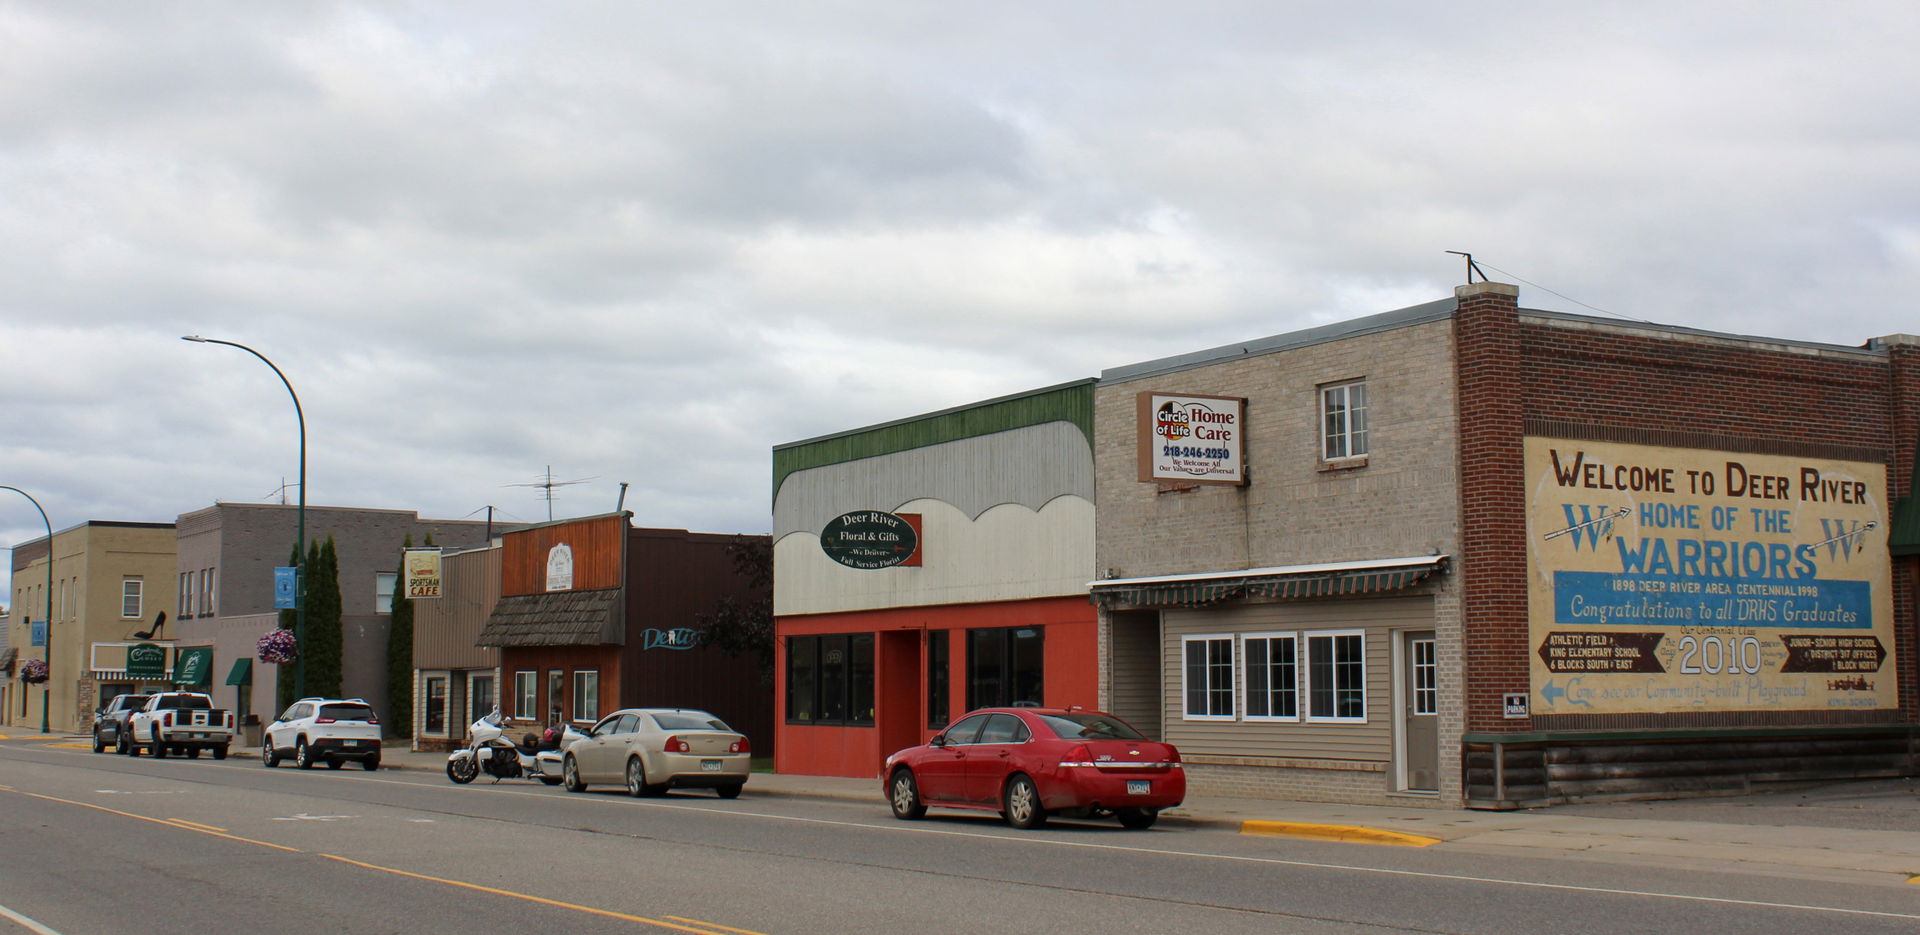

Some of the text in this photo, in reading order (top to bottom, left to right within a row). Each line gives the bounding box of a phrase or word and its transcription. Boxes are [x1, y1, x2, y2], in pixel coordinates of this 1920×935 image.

[1157, 409, 1189, 424] Circle
[1191, 408, 1235, 425] Home
[1156, 424, 1190, 437] of Life
[1195, 426, 1232, 441] Care
[1163, 445, 1230, 460] 218-246-2250
[1174, 465, 1193, 473] Values
[1206, 467, 1235, 475] Universal
[1183, 459, 1210, 467] Welcome
[1212, 460, 1221, 468] All
[1550, 448, 1866, 505] WELCOME TO DEER RIVER
[842, 512, 899, 528] Deer River
[1639, 502, 1791, 534] HOME OF THE
[840, 531, 899, 541] Floral & Gifts
[840, 556, 854, 566] Full
[880, 556, 901, 567] Florist
[1615, 535, 1817, 580] WARRIORS
[411, 587, 440, 596] CAFE
[1612, 579, 1819, 598] 1898 DEER RIVER AREA CENTENNIAL 1998
[1570, 594, 1858, 624] Congratulations to all DRHS Graduates
[1550, 635, 1584, 646] ATHLETIC
[1585, 635, 1608, 646] FIELD
[1838, 638, 1853, 648] HIGH
[1854, 638, 1878, 648] SCHOOL
[1550, 647, 1641, 658] KING ELEMENTARY SCHOOL
[1678, 635, 1762, 675] 2010
[1550, 659, 1555, 670] 6
[1557, 660, 1585, 670] BLOCKS
[1586, 660, 1609, 670] SOUTH
[1615, 660, 1633, 670] EAST
[1837, 660, 1857, 670] BLOCK
